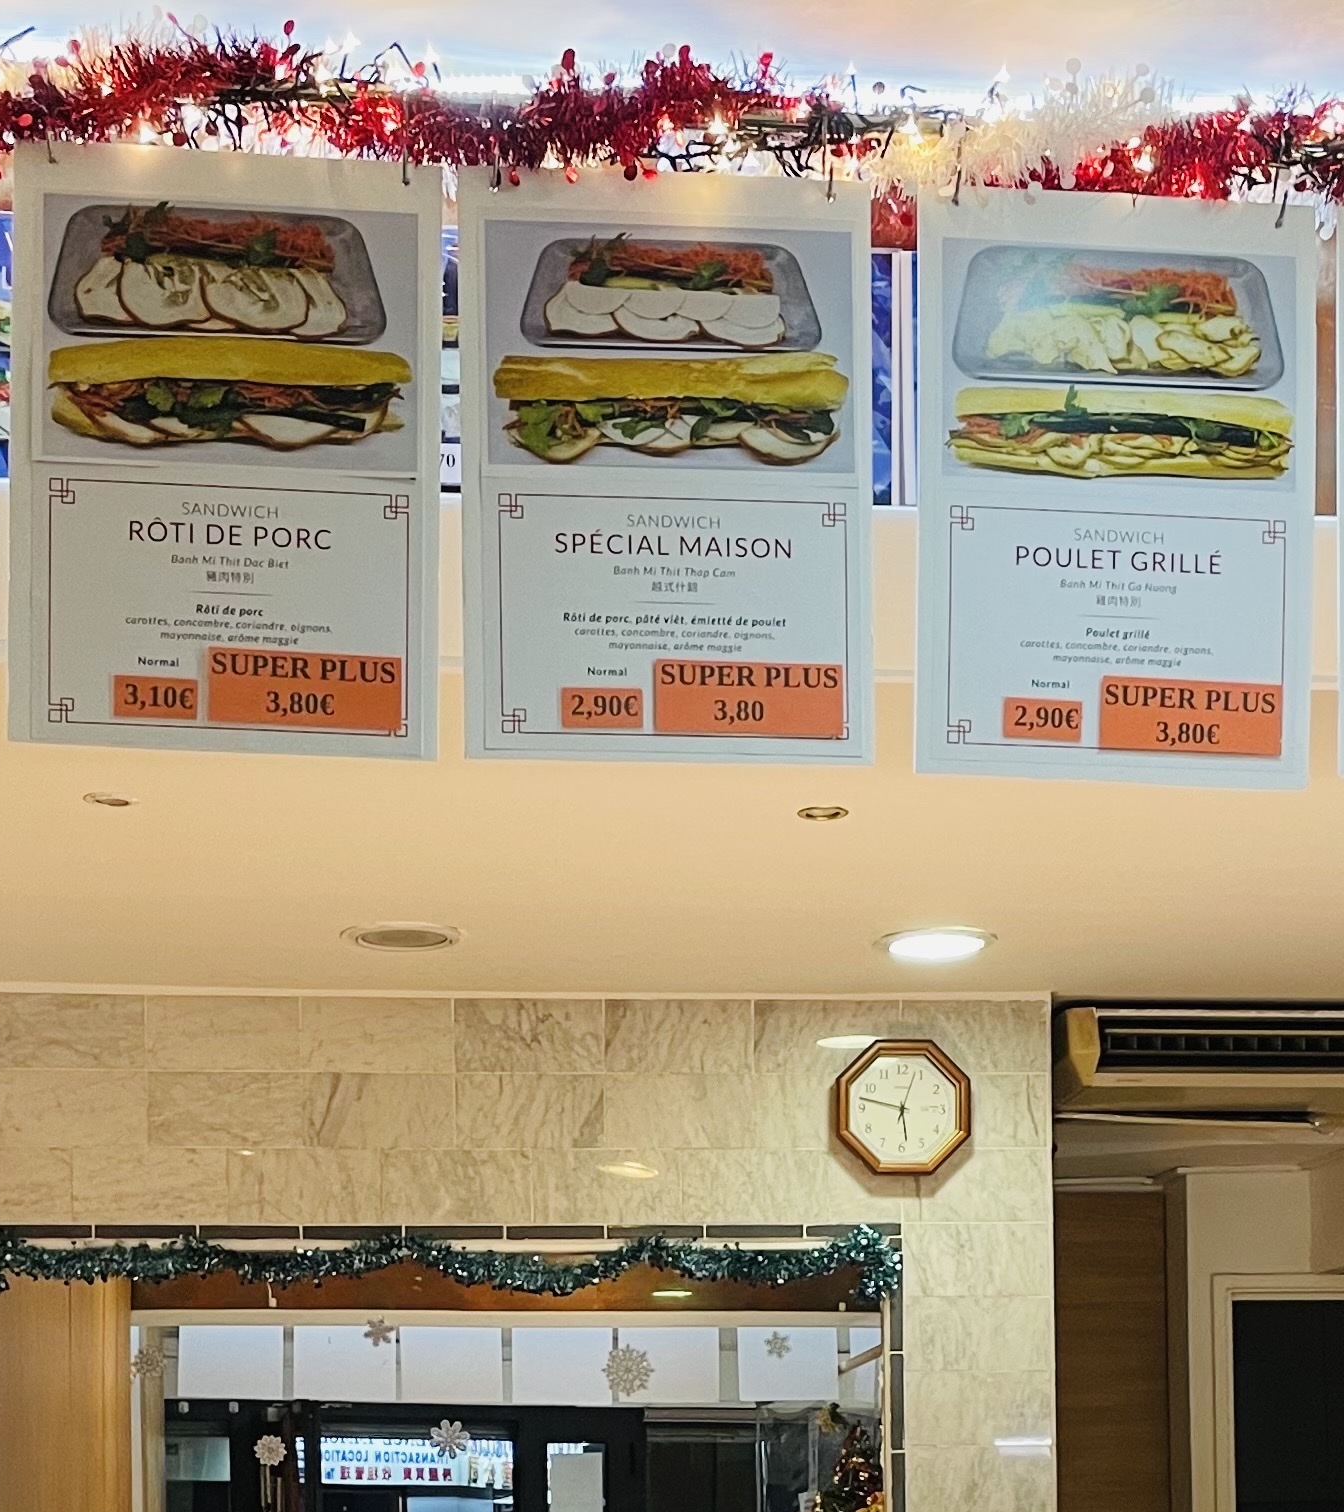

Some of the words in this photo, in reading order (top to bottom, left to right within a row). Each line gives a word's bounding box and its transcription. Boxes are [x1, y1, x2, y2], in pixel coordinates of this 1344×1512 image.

[181, 502, 279, 519] SANDWICH
[627, 514, 721, 530] SANDWICH
[129, 517, 194, 543] RÔTI
[207, 524, 243, 546] DE
[254, 527, 332, 550] PORC
[1074, 528, 1165, 545] SANDWICH
[555, 529, 669, 555] SPÉCIAL
[680, 536, 792, 559] MAISON
[171, 554, 198, 565] Banh
[202, 555, 216, 566] Mi
[1016, 546, 1122, 570] POULET
[1131, 550, 1222, 575] GRILLÉ
[196, 604, 218, 615] Rôti
[222, 605, 236, 615] de
[239, 606, 264, 618] porc
[563, 612, 586, 623] Rôti
[589, 613, 602, 623] de
[736, 616, 749, 627] de
[752, 617, 786, 629] poulet
[1086, 627, 1119, 639] Poulet
[138, 656, 179, 667] Normal
[212, 652, 310, 680] SUPER
[320, 659, 396, 684] PLUS
[587, 666, 627, 677] Normal
[661, 664, 755, 687] SUPER
[765, 666, 838, 689] PLUS
[1031, 679, 1070, 689] Normal
[124, 683, 194, 711] 3,10€
[1105, 684, 1195, 709] SUPER
[1205, 690, 1276, 714] PLUS
[266, 691, 334, 717] 3,80€
[571, 694, 638, 720] 2,90€
[714, 699, 764, 723] 3,80
[1015, 705, 1079, 731] 2,90€
[1156, 720, 1220, 745] 3,80€
[880, 1070, 889, 1080] 11
[896, 1064, 909, 1075] 12
[919, 1070, 923, 1080] 1
[865, 1083, 876, 1093] 10
[933, 1084, 940, 1095] 2
[859, 1103, 866, 1113] 9
[940, 1104, 946, 1115] 3
[865, 1123, 872, 1133] 8
[933, 1124, 939, 1134] 4
[880, 1138, 886, 1148] 7
[898, 1143, 905, 1152] 6
[919, 1138, 925, 1148] 5
